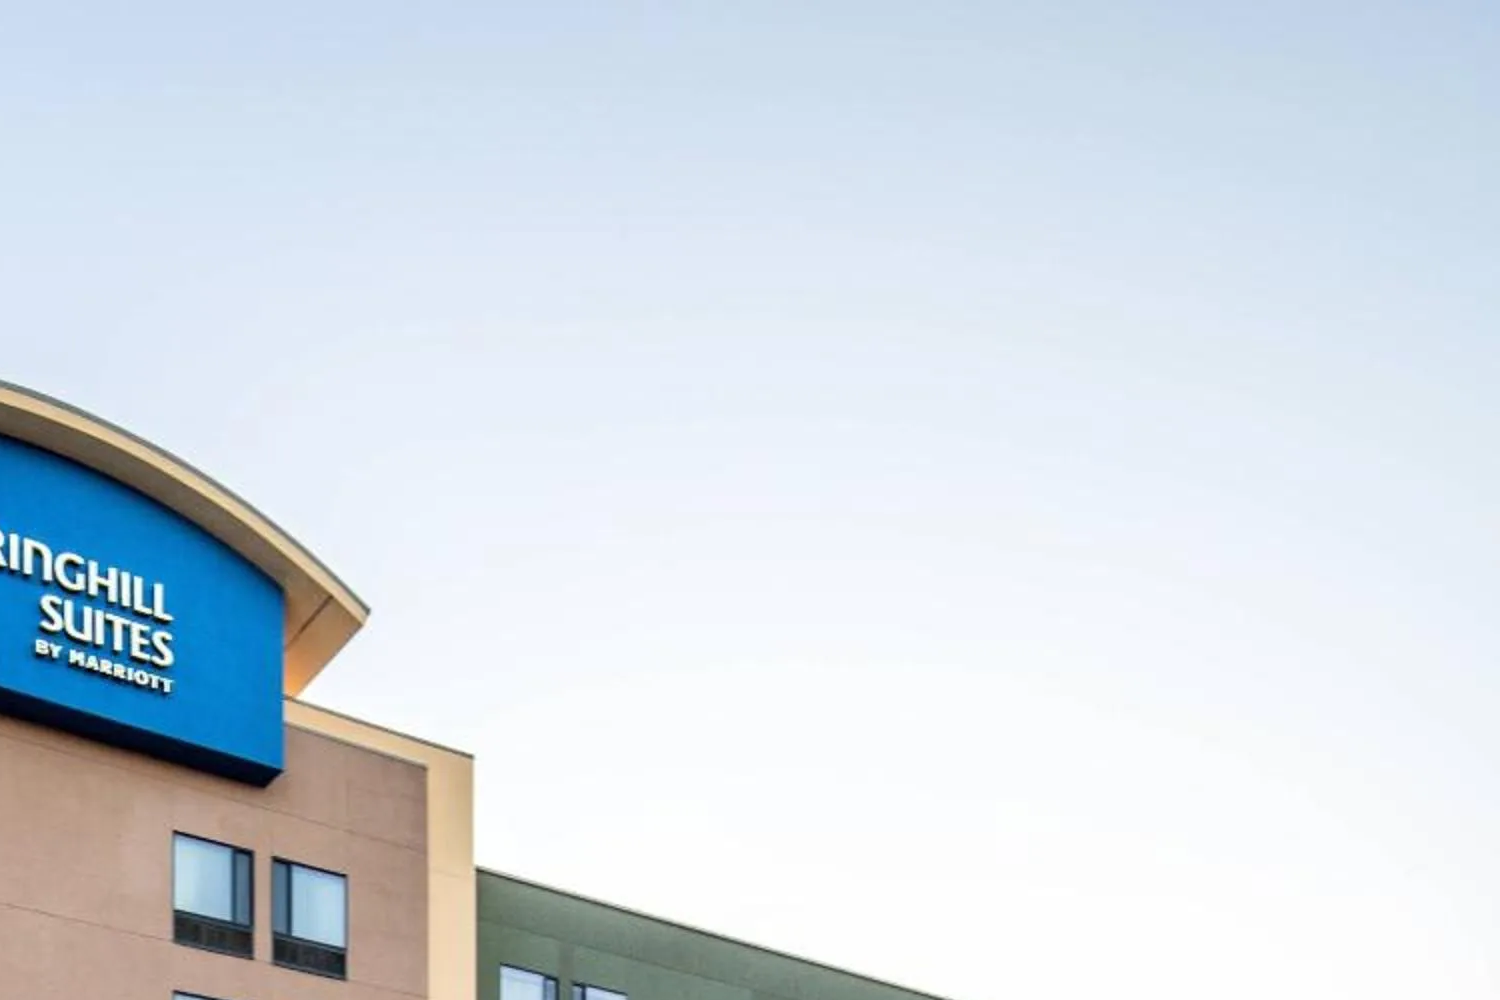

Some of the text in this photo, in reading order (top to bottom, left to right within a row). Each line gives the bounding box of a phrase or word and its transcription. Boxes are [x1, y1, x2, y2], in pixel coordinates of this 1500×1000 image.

[40, 594, 175, 667] SUITES
[35, 639, 175, 693] BY MARRIOTT
